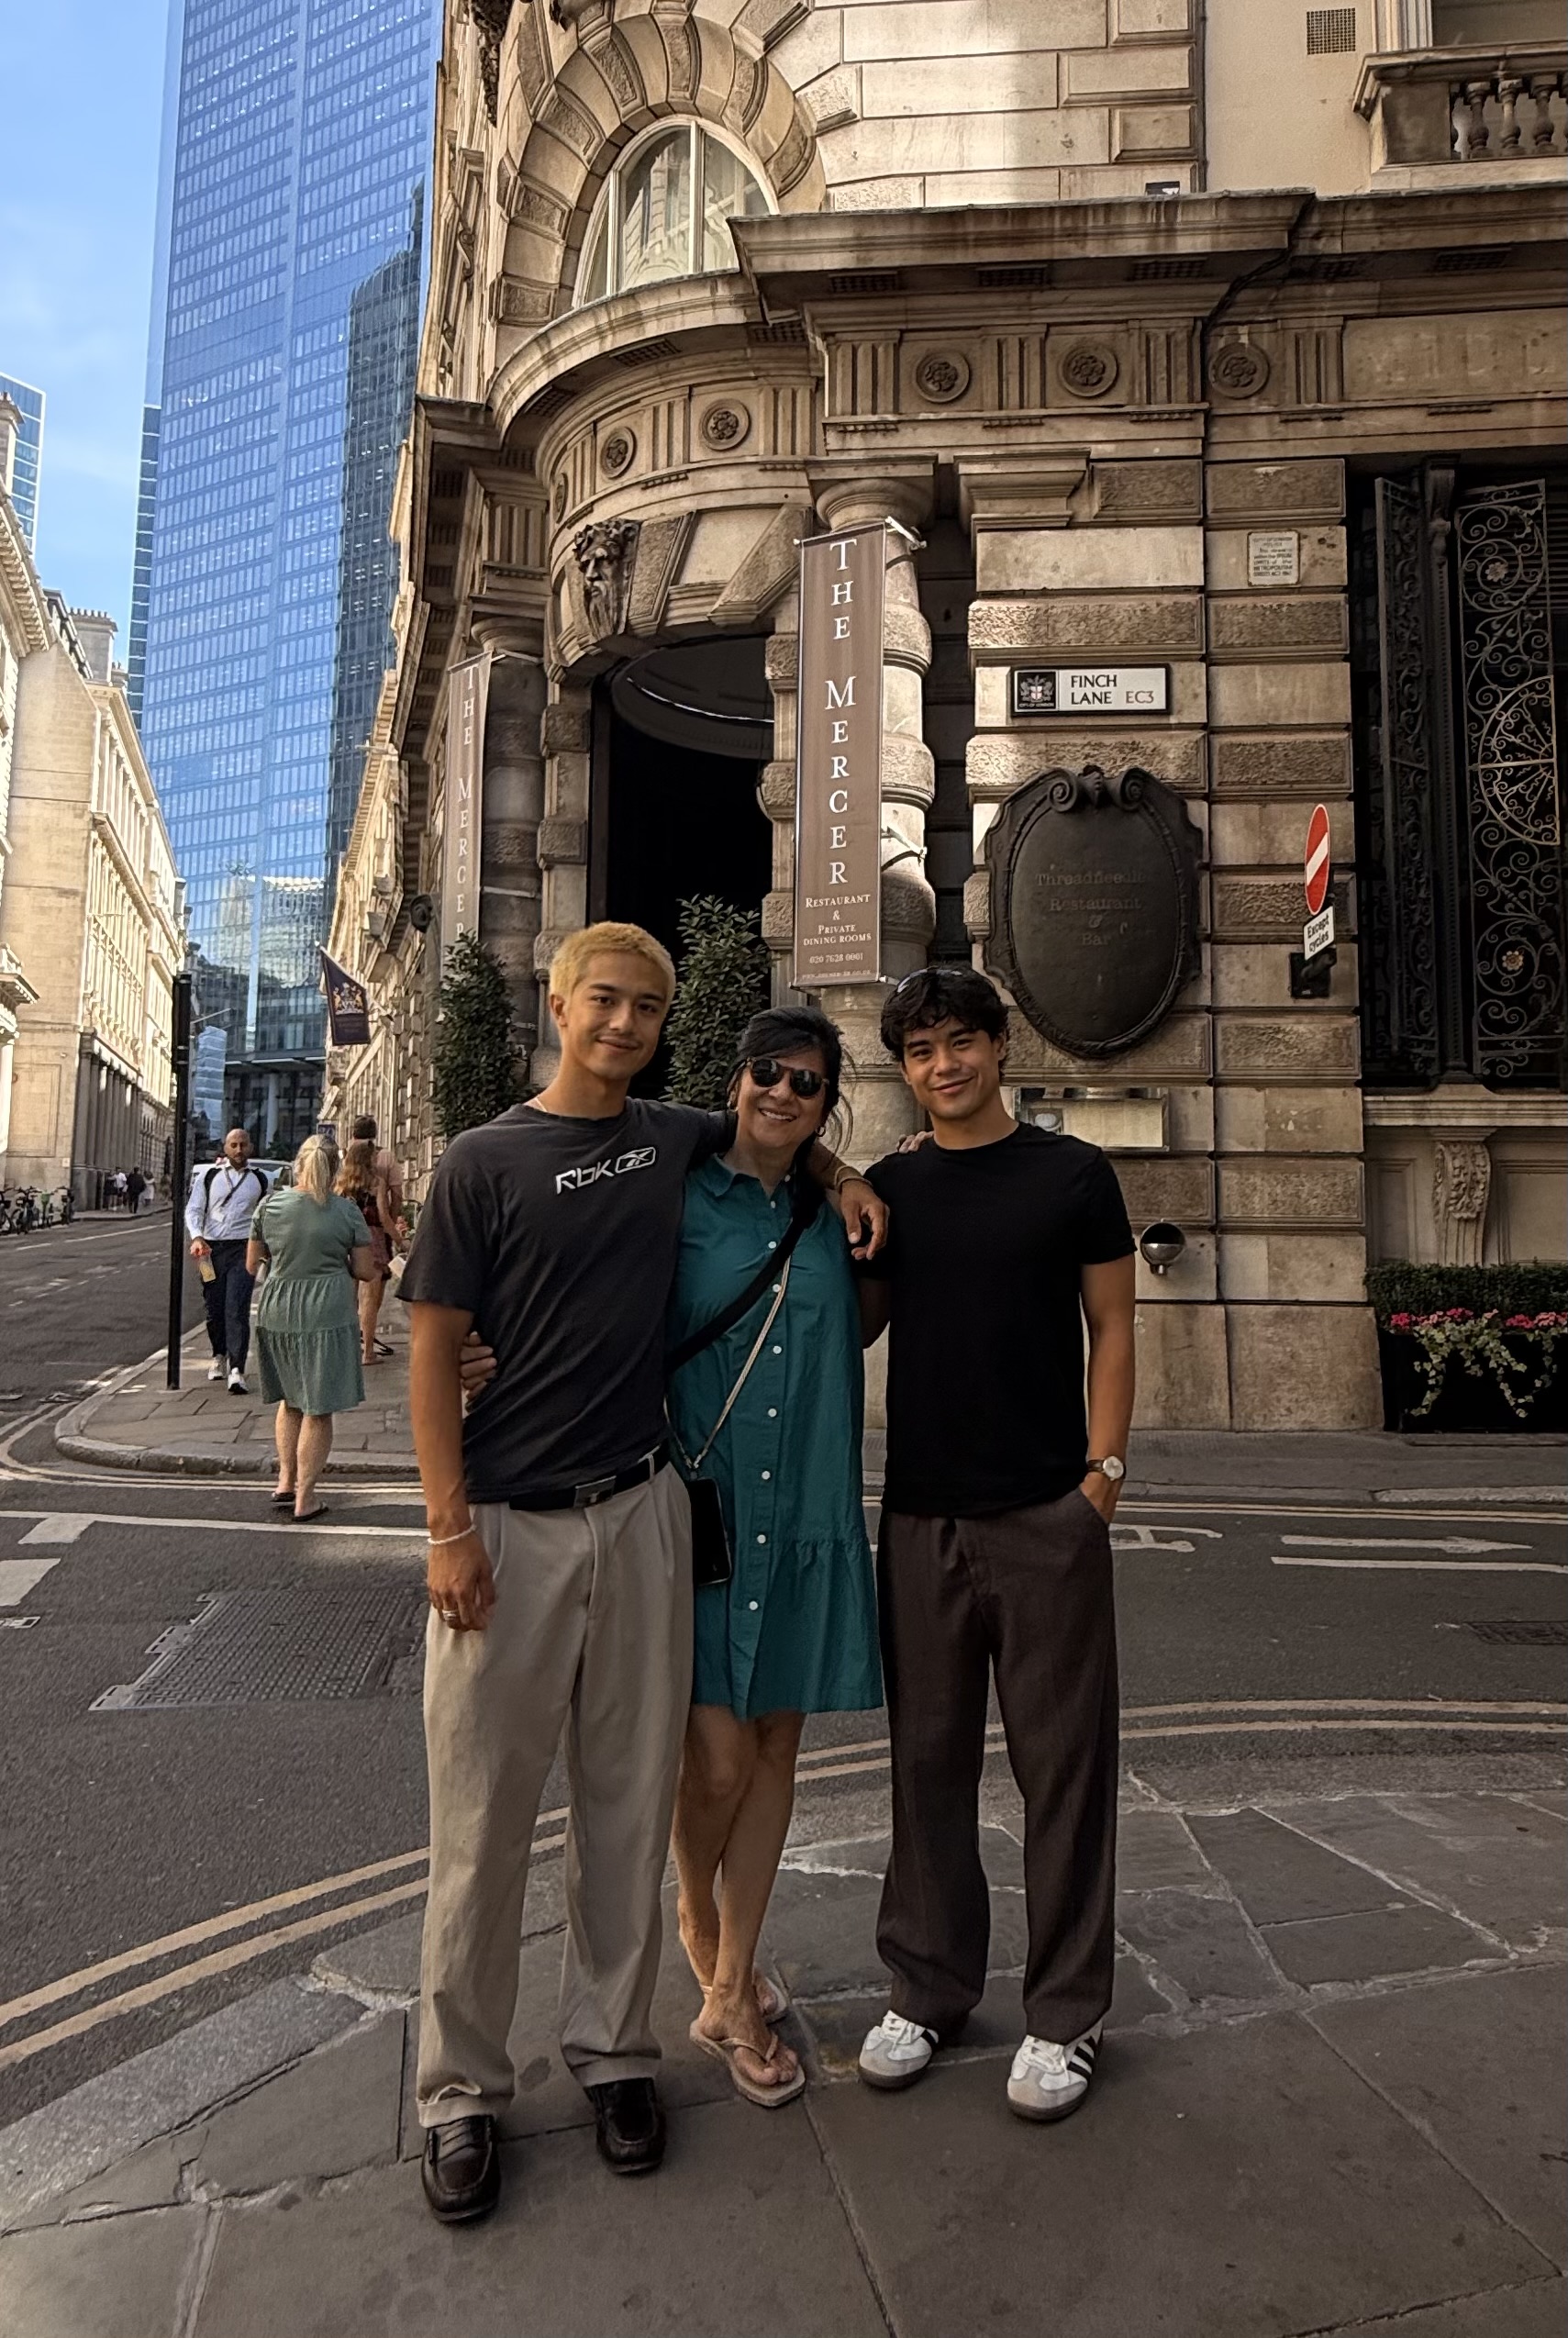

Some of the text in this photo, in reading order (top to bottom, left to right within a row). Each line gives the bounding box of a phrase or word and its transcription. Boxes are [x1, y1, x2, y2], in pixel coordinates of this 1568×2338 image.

[1071, 674, 1118, 688] FINCH
[463, 662, 479, 745] THE
[1071, 690, 1154, 705] LANE EC3
[825, 539, 858, 885] THE MERCER
[806, 894, 871, 908] RESTAURANT
[1050, 898, 1143, 911] Restaurant
[832, 909, 840, 921] &
[817, 924, 856, 935] PRIVATE
[1307, 912, 1329, 939] Except
[803, 932, 872, 946] DINING ROOMS
[1081, 932, 1110, 946] Bar
[1309, 930, 1329, 952] cycles
